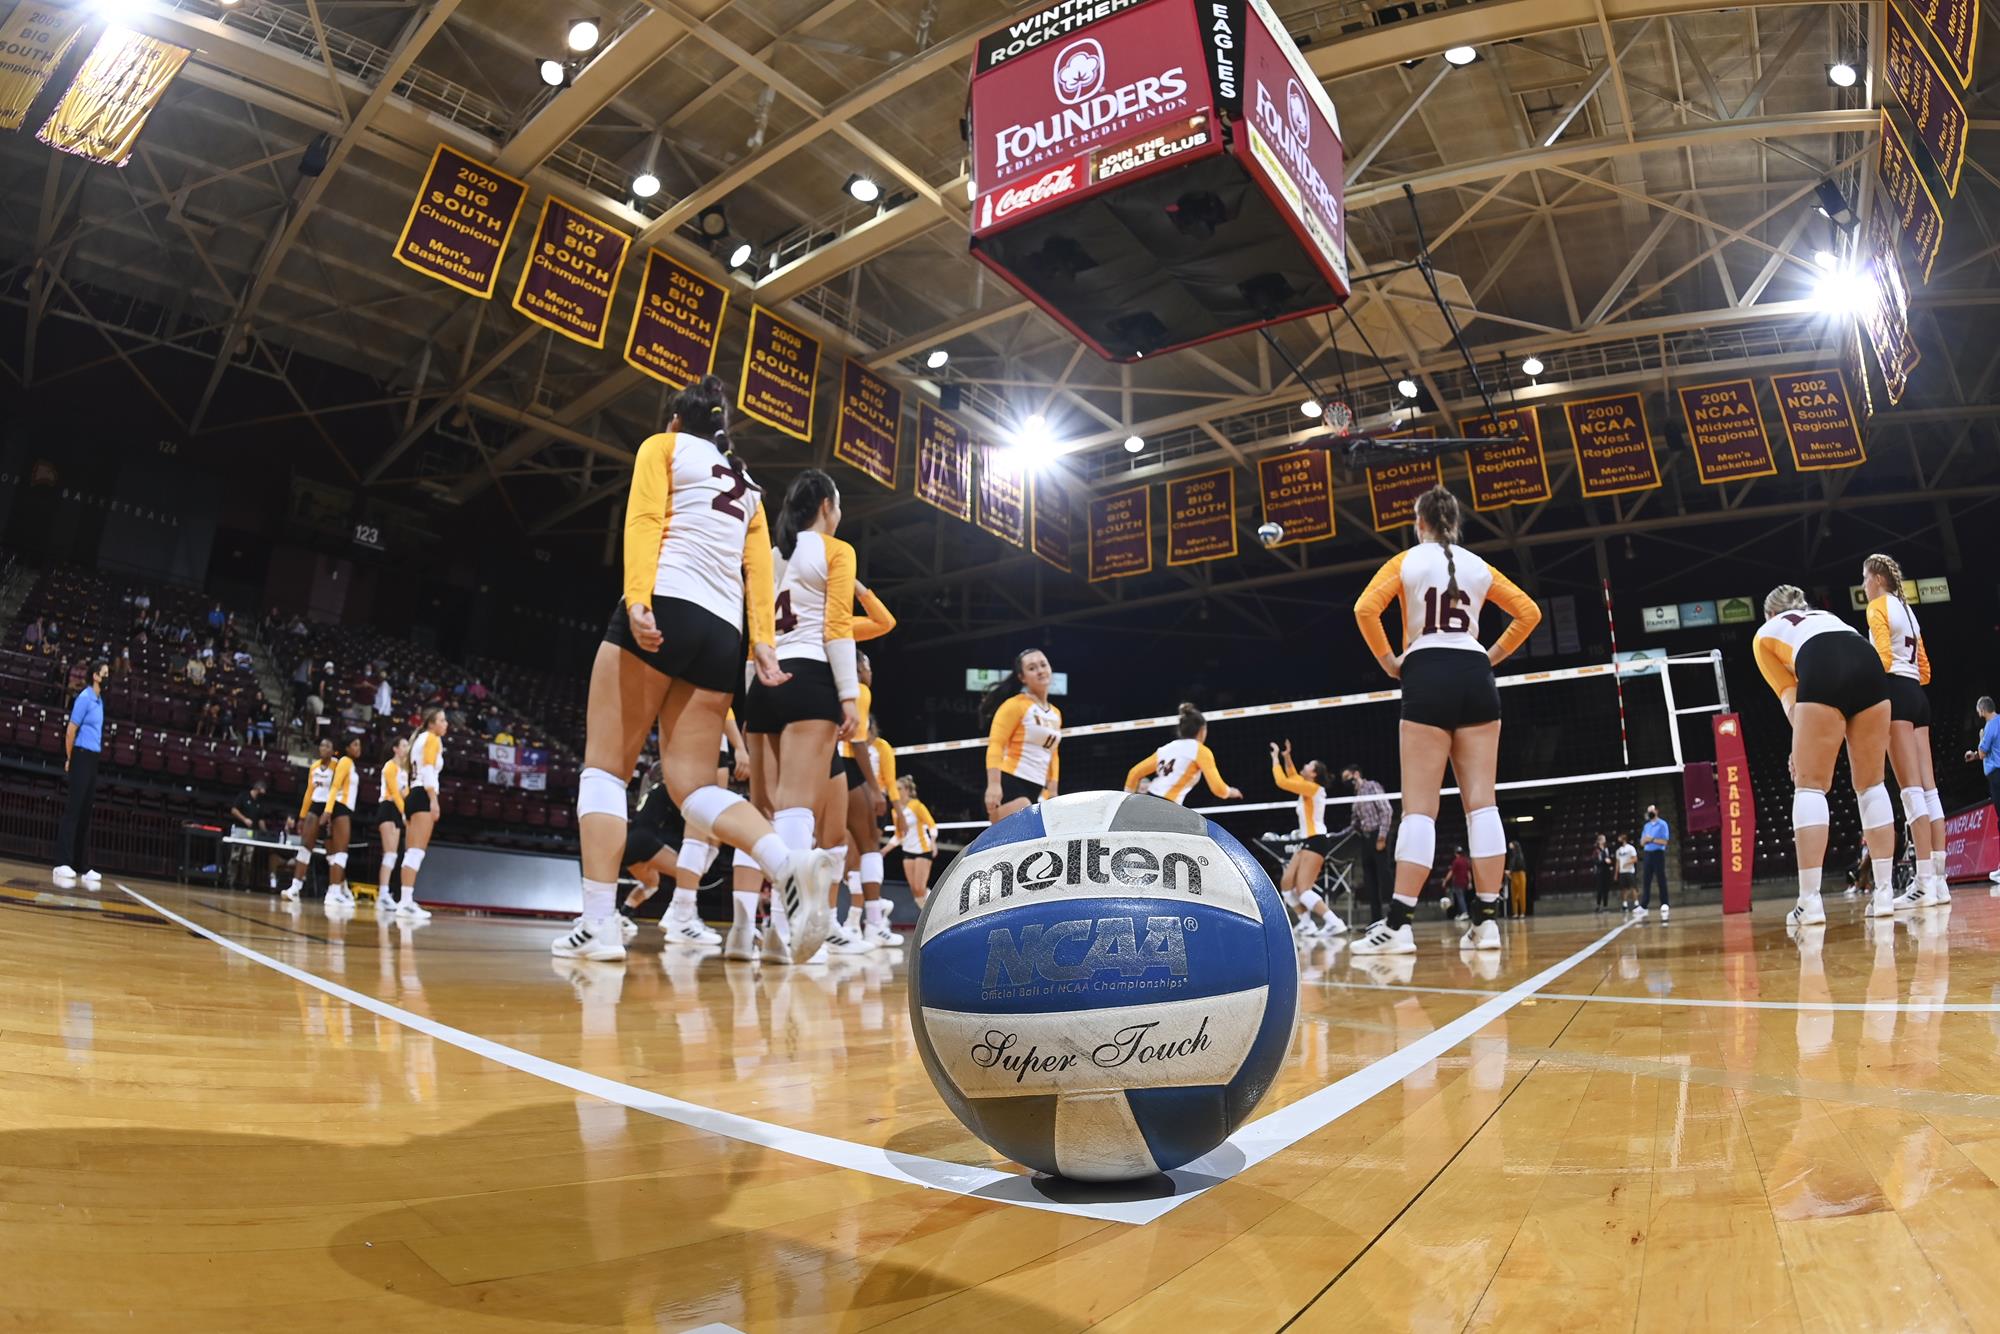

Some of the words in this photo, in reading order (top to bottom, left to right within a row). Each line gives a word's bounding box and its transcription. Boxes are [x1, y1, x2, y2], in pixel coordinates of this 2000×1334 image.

[19, 27, 50, 43] BIG
[991, 0, 1136, 65] ROCKTHEH
[1212, 3, 1236, 99] EAGLES
[1899, 36, 1912, 102] NCAA
[995, 66, 1188, 168] FOUNDERS
[997, 144, 1063, 178] FEDERAL
[1070, 118, 1128, 148] CREDIT
[1136, 96, 1188, 122] UNION
[1099, 147, 1133, 168] JOIN
[1135, 136, 1165, 152] THE
[1099, 150, 1156, 180] EAGLE
[1159, 132, 1208, 157] CLUB
[1256, 78, 1338, 225] FOUNDERS
[457, 166, 498, 193] 2020
[454, 183, 489, 207] BIG
[431, 190, 502, 231] SOUTH
[419, 203, 500, 248] Champions
[566, 218, 605, 245] 2017
[428, 238, 472, 265] Men's
[564, 234, 597, 258] BIG
[407, 241, 486, 284] Basketball
[544, 242, 609, 283] SOUTH
[534, 254, 609, 298] Champions
[669, 271, 705, 298] 2010
[544, 288, 584, 316] Men's
[668, 286, 699, 310] BIG
[526, 292, 597, 333] Basketball
[650, 293, 712, 333] SOUTH
[643, 305, 711, 348] Champions
[651, 342, 689, 368] Men's
[770, 340, 798, 362] BIG
[634, 345, 701, 384] Basketball
[755, 349, 810, 384] SOUTH
[750, 360, 811, 398] Champions
[1791, 379, 1828, 394] 2002
[760, 390, 793, 414] Men's
[861, 389, 884, 409] BIG
[1701, 390, 1737, 405] 2001
[1787, 392, 1839, 409] NCAA
[746, 394, 806, 429] Basketball
[850, 395, 894, 430] SOUTH
[1586, 405, 1624, 419] 2000
[1695, 403, 1750, 421] NCAA
[1798, 408, 1838, 420] South
[1580, 417, 1636, 435] NCAA
[1696, 417, 1756, 434] Midwest
[1699, 427, 1760, 445] Regional
[1792, 418, 1849, 433] Regional
[1583, 441, 1645, 458] Regional
[1593, 432, 1631, 445] West
[1810, 441, 1842, 451] Men's
[1477, 455, 1538, 474] Regional
[1484, 446, 1526, 461] South
[1706, 457, 1766, 474] Basketball
[1717, 450, 1751, 462] Men's
[1801, 447, 1857, 461] Basketball
[1281, 471, 1309, 485] BIG
[1376, 461, 1432, 481] SOUTH
[1589, 470, 1651, 486] Basketball
[1600, 464, 1636, 475] Men's
[711, 463, 747, 522] 2
[1185, 480, 1216, 495] 2000
[1270, 481, 1323, 500] SOUTH
[1374, 475, 1437, 492] Champions
[1481, 483, 1542, 501] Basketball
[1493, 478, 1527, 490] Men's
[1176, 502, 1226, 519] SOUTH
[1188, 493, 1213, 505] BIG
[355, 525, 379, 544] 123
[1096, 519, 1143, 537] SOUTH
[1422, 587, 1471, 635] 16
[1727, 765, 1743, 873] EAGLES
[960, 838, 1203, 916] molten
[984, 916, 1190, 988] NCAA
[981, 987, 1017, 1001] Official
[1019, 987, 1041, 999] Ball
[1043, 985, 1055, 996] of
[1058, 983, 1090, 994] NCAA
[1093, 977, 1182, 992] Championships
[971, 1029, 1078, 1083] Super
[1091, 1015, 1212, 1068] Touch
